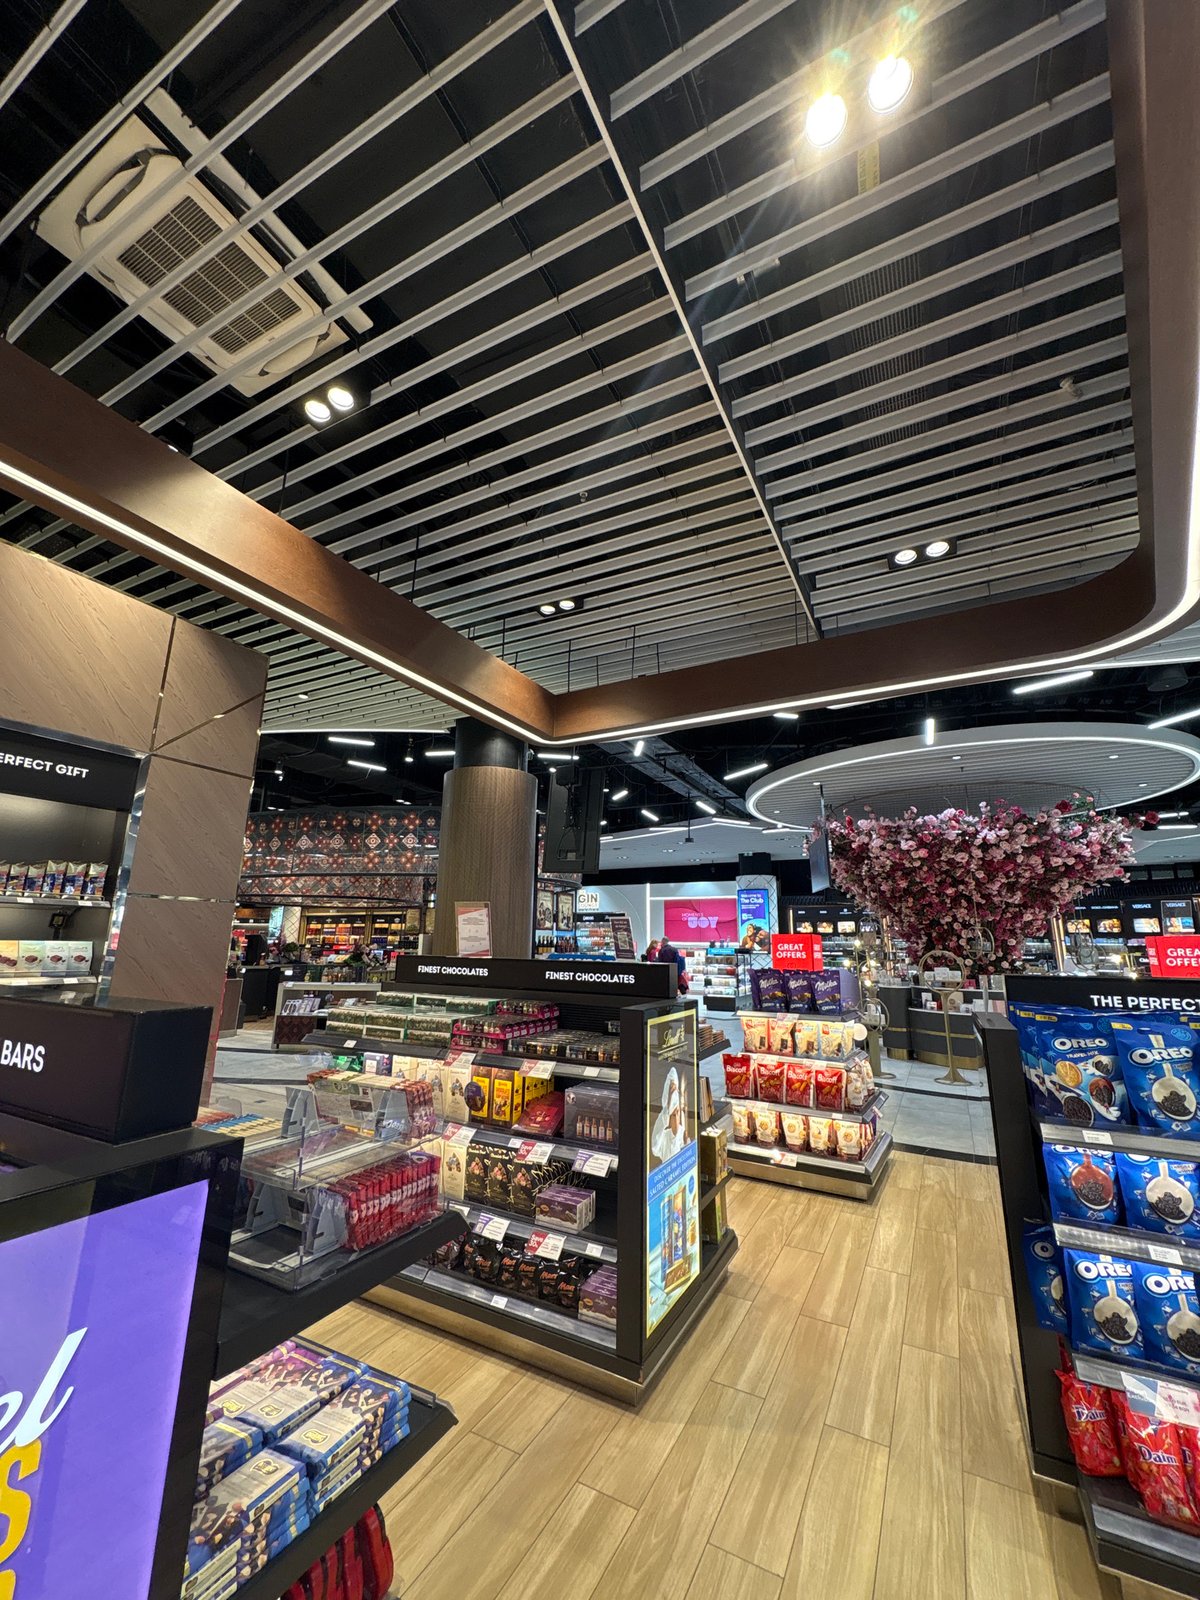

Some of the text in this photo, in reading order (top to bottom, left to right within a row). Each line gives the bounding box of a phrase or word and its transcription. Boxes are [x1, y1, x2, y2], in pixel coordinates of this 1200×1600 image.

[55, 764, 89, 778] GIFT
[579, 894, 598, 903] GIN
[777, 943, 803, 951] GREAT
[776, 951, 807, 959] OFFERS
[1166, 957, 1200, 966] OFFE
[418, 965, 489, 977] FINEST CHOCOLATES
[545, 971, 635, 983] FINEST CHOCOLATES
[759, 979, 779, 989] Milka
[788, 979, 808, 989] Milka
[815, 980, 838, 991] Milka
[1090, 995, 1123, 1008] THE
[1053, 1037, 1108, 1051] OREO
[0, 1039, 46, 1073] BARS
[1131, 1047, 1193, 1066] OREO
[726, 1065, 747, 1073] Biscoff
[760, 1066, 781, 1075] Biscoff
[787, 1070, 808, 1080] Biscoff
[817, 1073, 838, 1083] Biscoff
[649, 1180, 665, 1197] SALTED
[531, 1234, 544, 1243] Save
[1074, 1405, 1108, 1421] Daim
[1135, 1442, 1180, 1464] Daim
